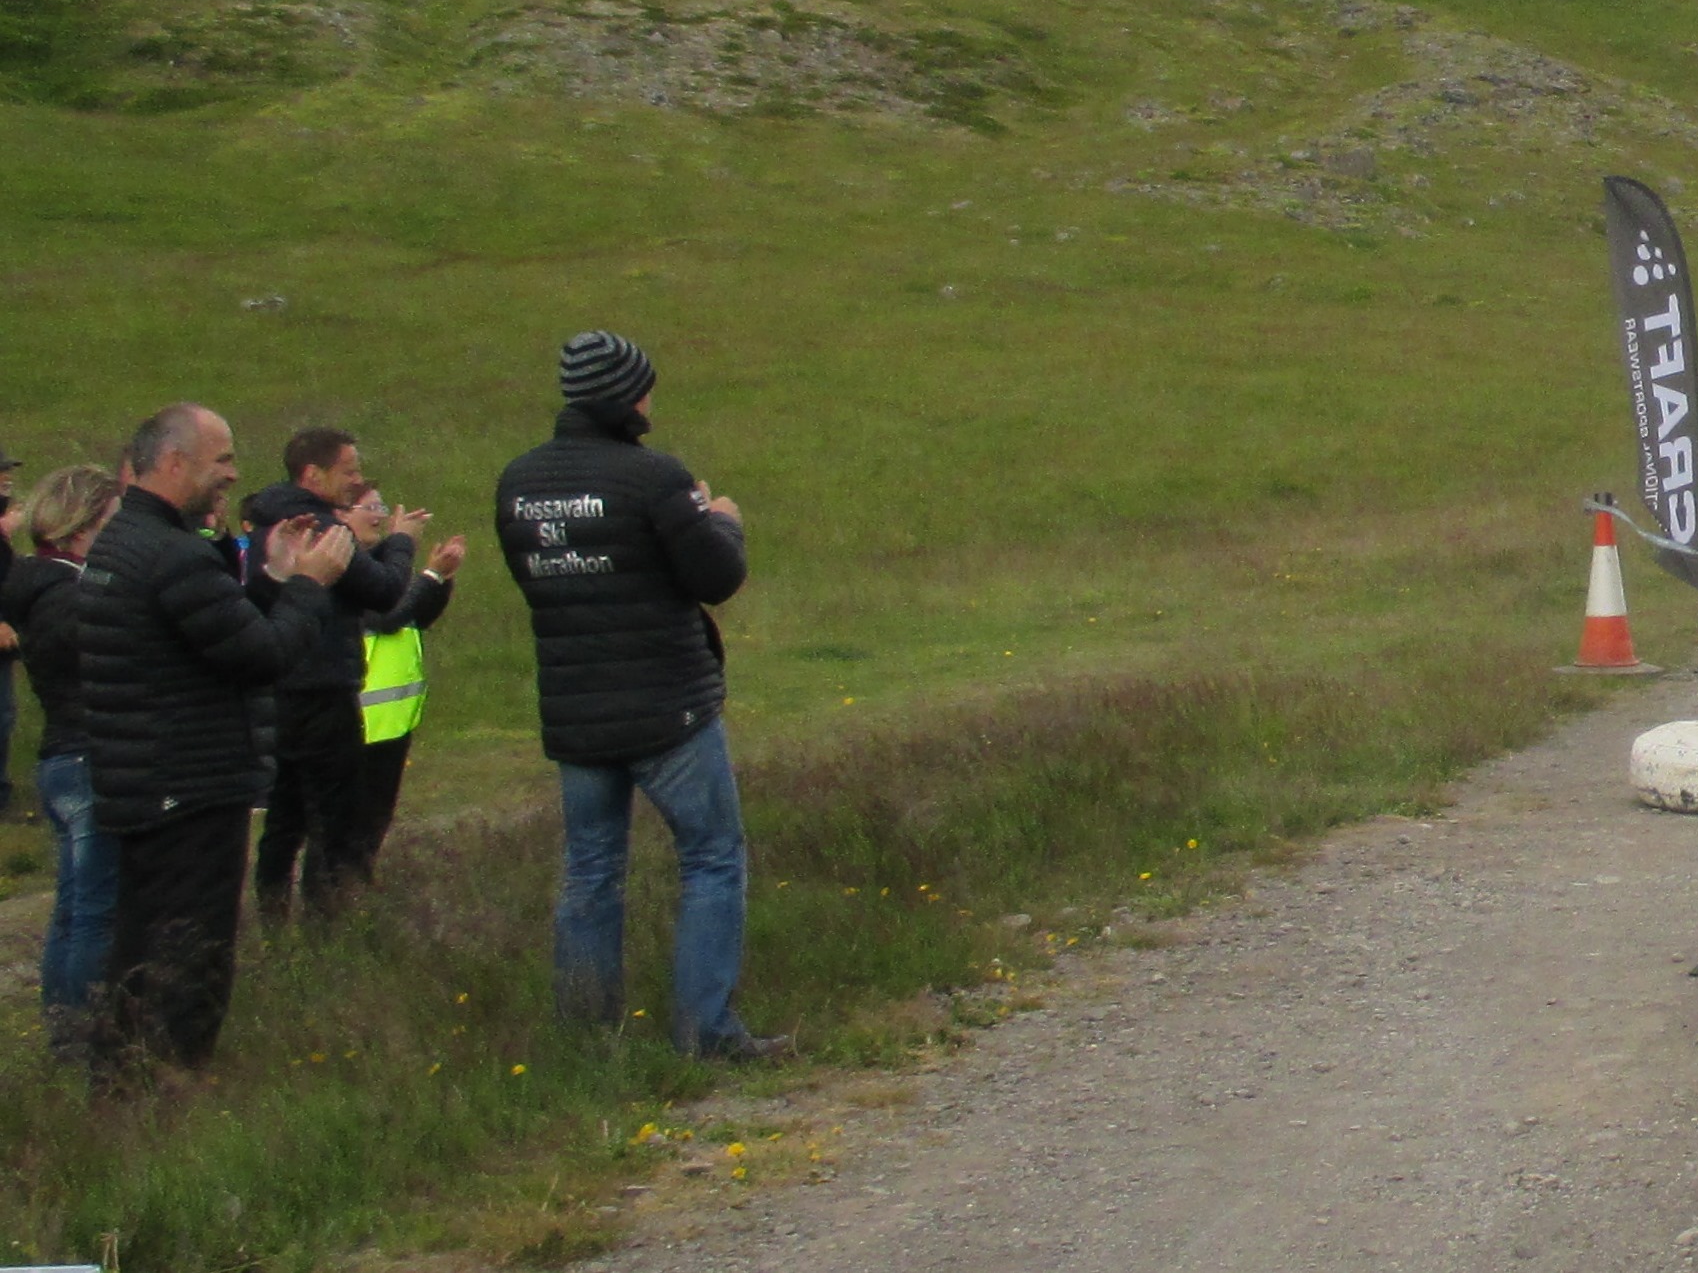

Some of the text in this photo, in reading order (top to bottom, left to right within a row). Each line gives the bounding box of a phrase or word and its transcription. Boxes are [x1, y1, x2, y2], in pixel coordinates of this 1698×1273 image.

[514, 494, 604, 520] Fossavatn
[538, 522, 567, 547] Ski
[527, 551, 614, 577] Marathon
